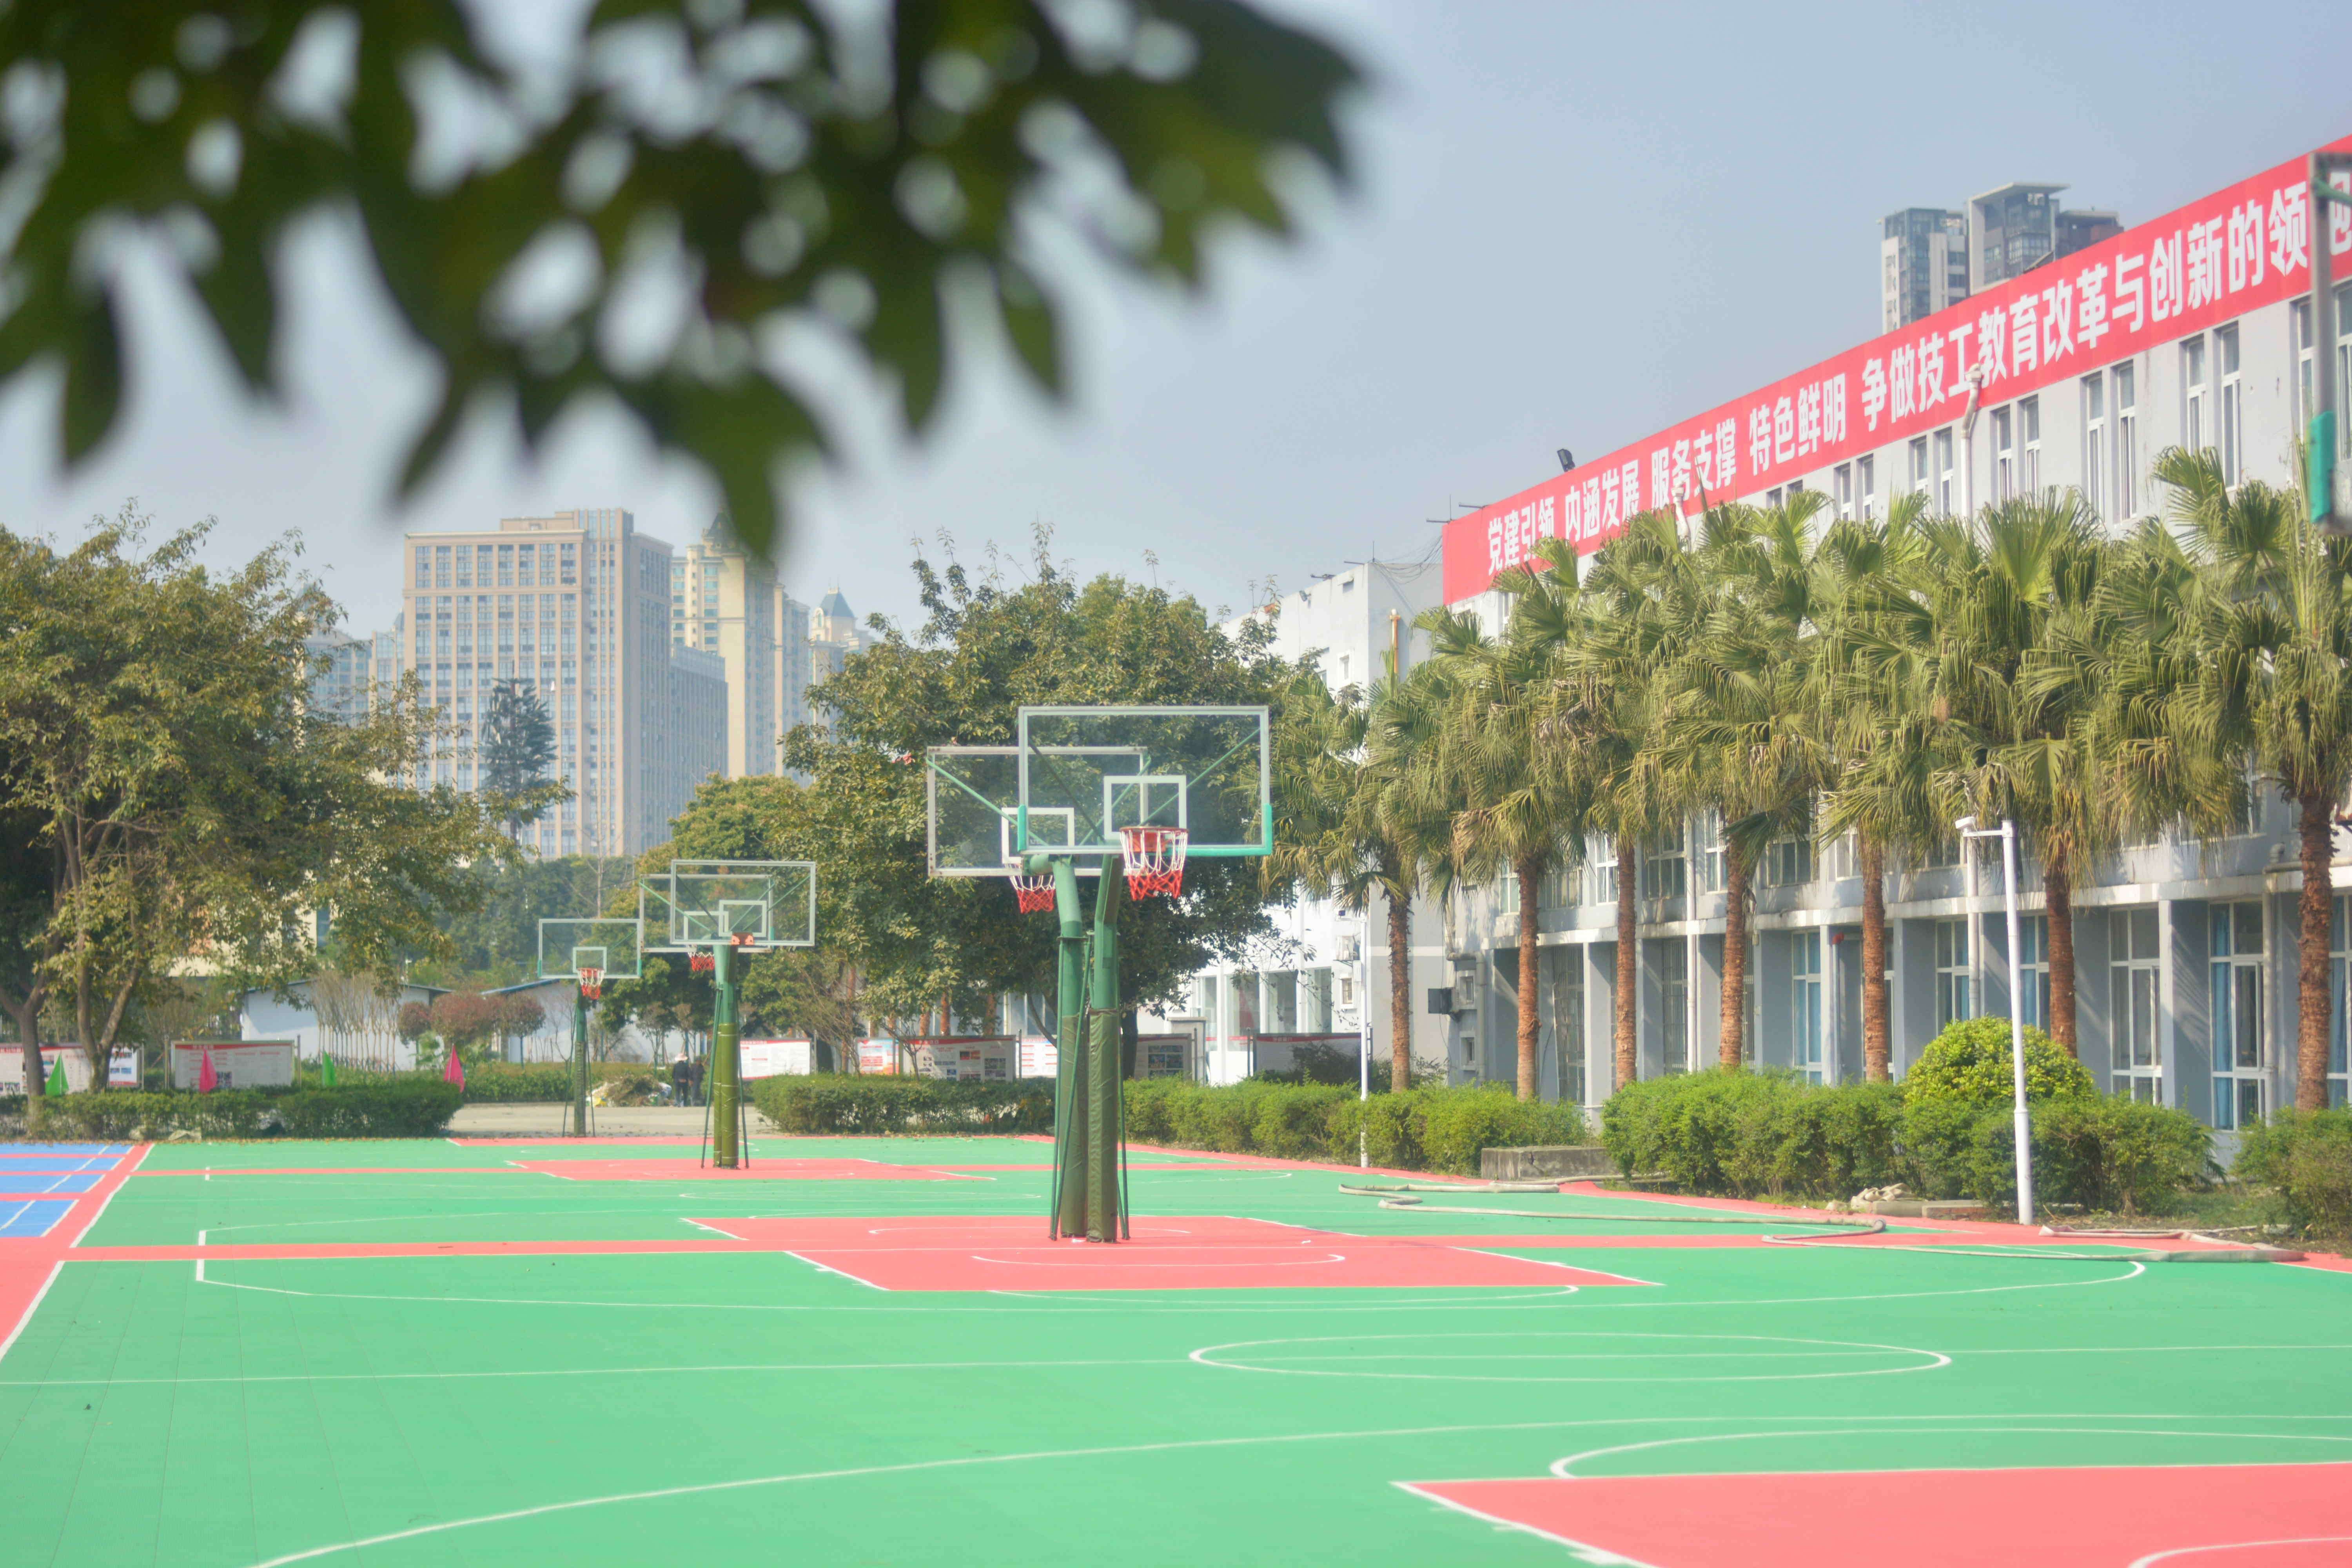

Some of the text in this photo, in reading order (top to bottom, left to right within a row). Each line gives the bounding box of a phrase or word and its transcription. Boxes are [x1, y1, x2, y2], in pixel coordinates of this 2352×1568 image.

[1488, 496, 1555, 576] 党建引领
[1565, 459, 1639, 543] 内涵发展
[1651, 417, 1736, 510] 服务支撑
[1749, 373, 1846, 475] 特色鲜明
